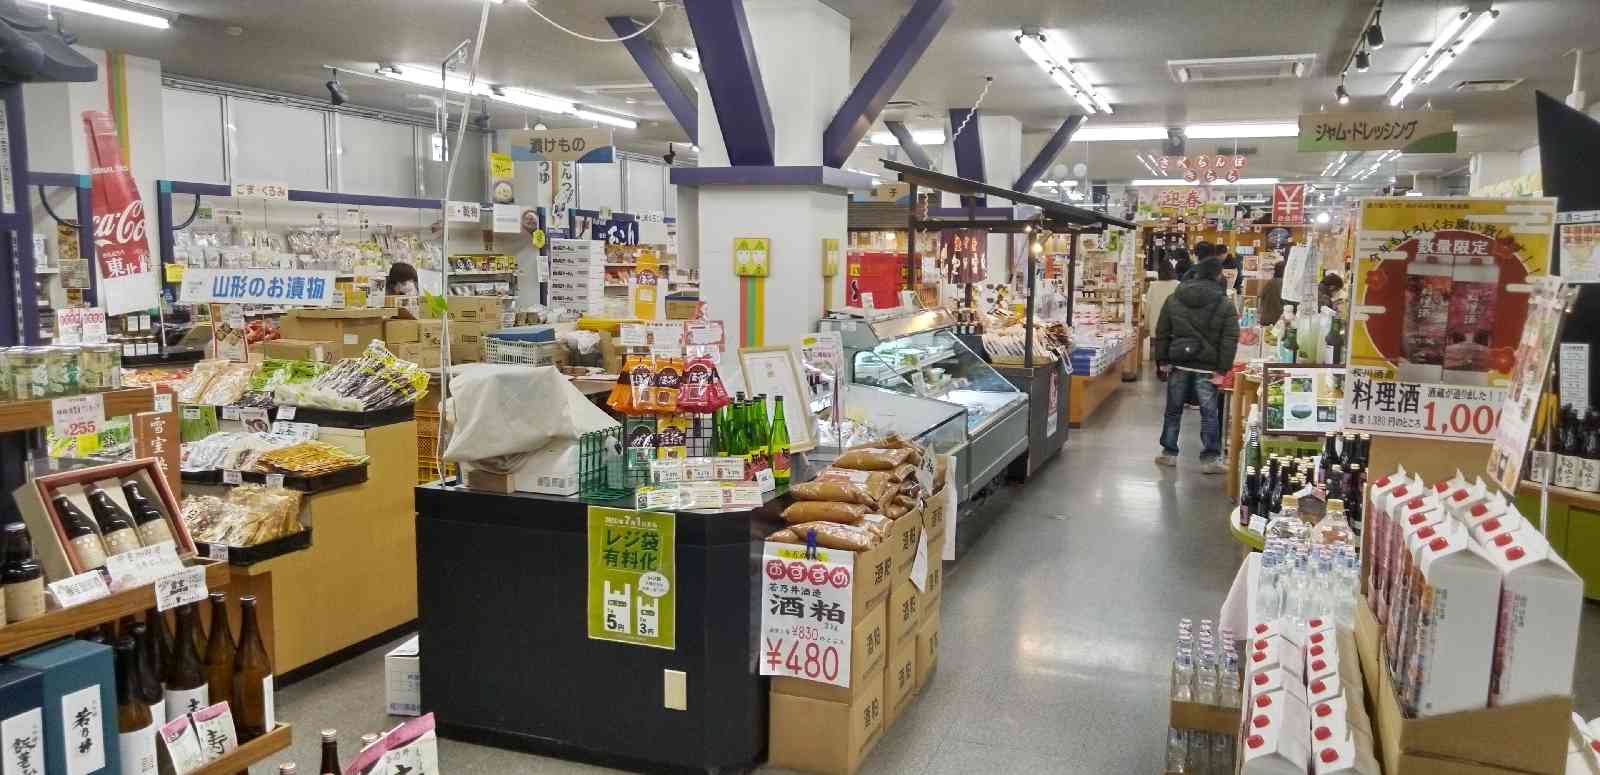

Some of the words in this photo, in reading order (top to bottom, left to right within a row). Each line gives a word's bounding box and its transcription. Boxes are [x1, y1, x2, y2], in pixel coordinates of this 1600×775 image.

[1315, 120, 1418, 141] ジャム・ドレッシング
[530, 137, 586, 153] 漬けもの
[1160, 191, 1202, 208] 迎春
[1417, 239, 1489, 256] 数量限定
[212, 274, 325, 299] 山形のお漬物
[1352, 379, 1420, 414] 料理酒
[1424, 401, 1503, 434] 1,00
[606, 529, 659, 552] レジ袋
[602, 548, 658, 572] 有料化
[767, 560, 849, 588] おすすめ
[769, 594, 846, 625] 酒粕
[766, 637, 839, 681] ¥480
